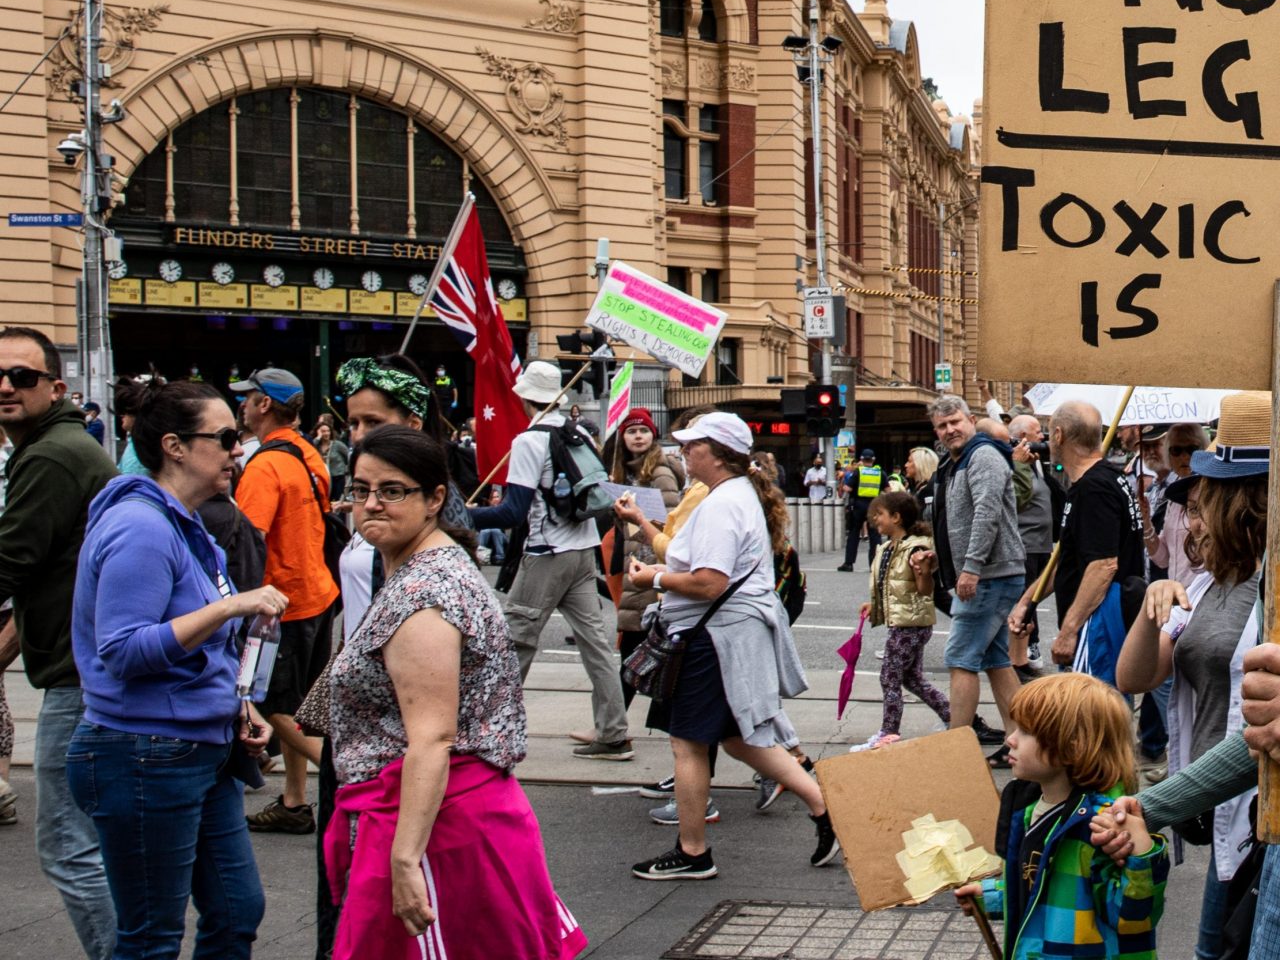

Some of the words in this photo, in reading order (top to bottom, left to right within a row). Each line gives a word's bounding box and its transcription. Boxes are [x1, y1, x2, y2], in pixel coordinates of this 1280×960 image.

[11, 214, 52, 223] Swanston
[53, 214, 62, 223] St
[981, 165, 1261, 264] TOXIC
[175, 227, 275, 250] FLINDERS
[300, 236, 368, 256] STREET
[605, 294, 635, 313] STOP
[639, 309, 693, 344] STEALING
[1080, 272, 1162, 347] IS
[595, 311, 636, 340] RIGHTS
[652, 337, 704, 372] DEMOCRACY
[1121, 401, 1198, 421] OERCION
[1134, 392, 1173, 404] NOT
